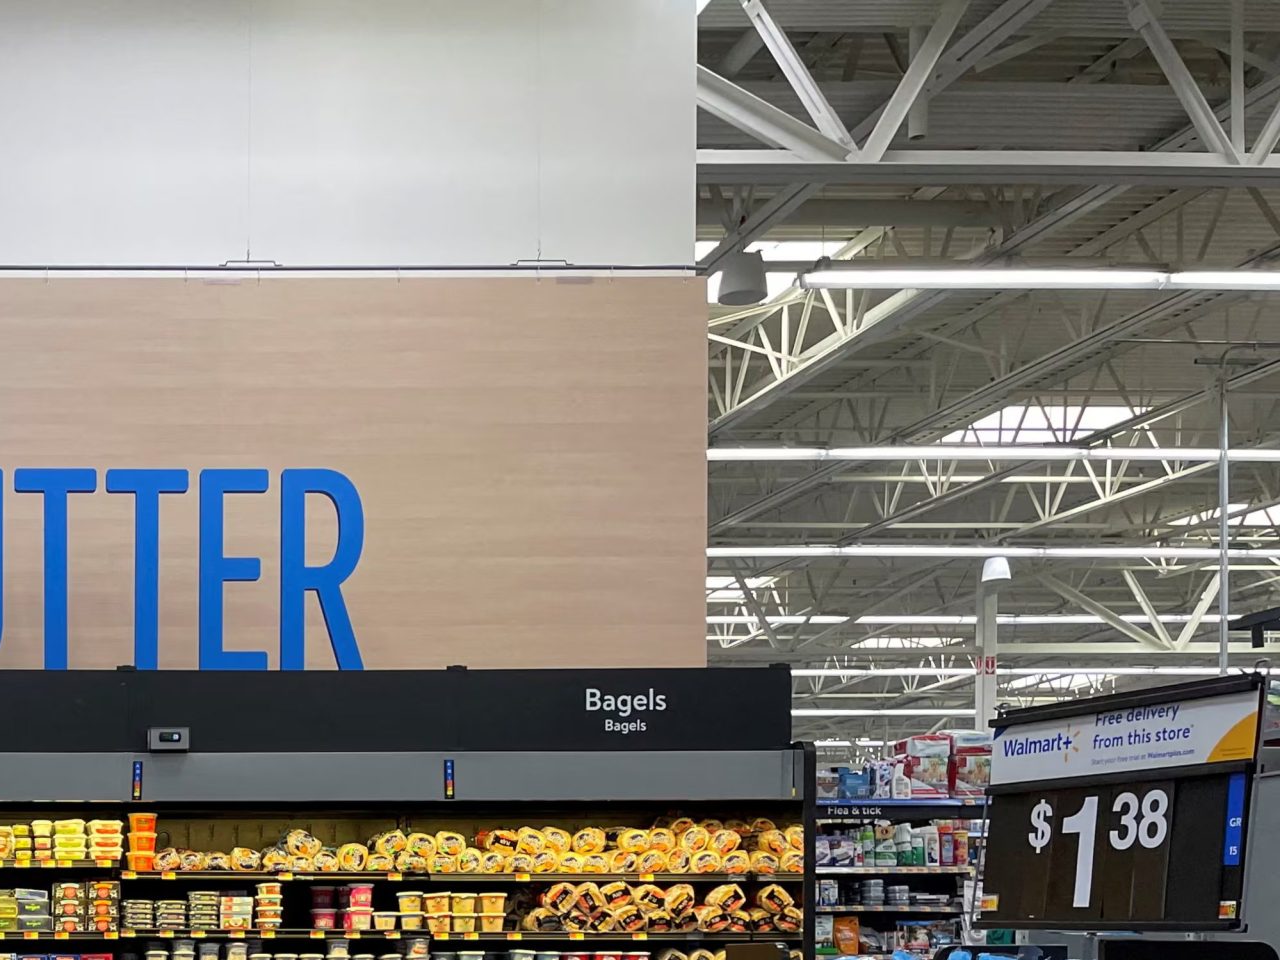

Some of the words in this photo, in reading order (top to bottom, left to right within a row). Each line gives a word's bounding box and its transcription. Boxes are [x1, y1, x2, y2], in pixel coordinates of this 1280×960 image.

[584, 688, 668, 716] Bagels
[603, 718, 647, 734] Bagels
[1095, 712, 1123, 727] Free
[1126, 705, 1180, 723] delivery
[1003, 733, 1073, 758] Walmart+
[1093, 735, 1124, 750] from
[1127, 731, 1152, 746] this
[827, 806, 849, 815] Flea
[851, 806, 860, 815] &
[861, 806, 882, 815] tick
[1028, 799, 1053, 854] $
[1062, 796, 1099, 908] 1
[1109, 789, 1169, 851] 38
